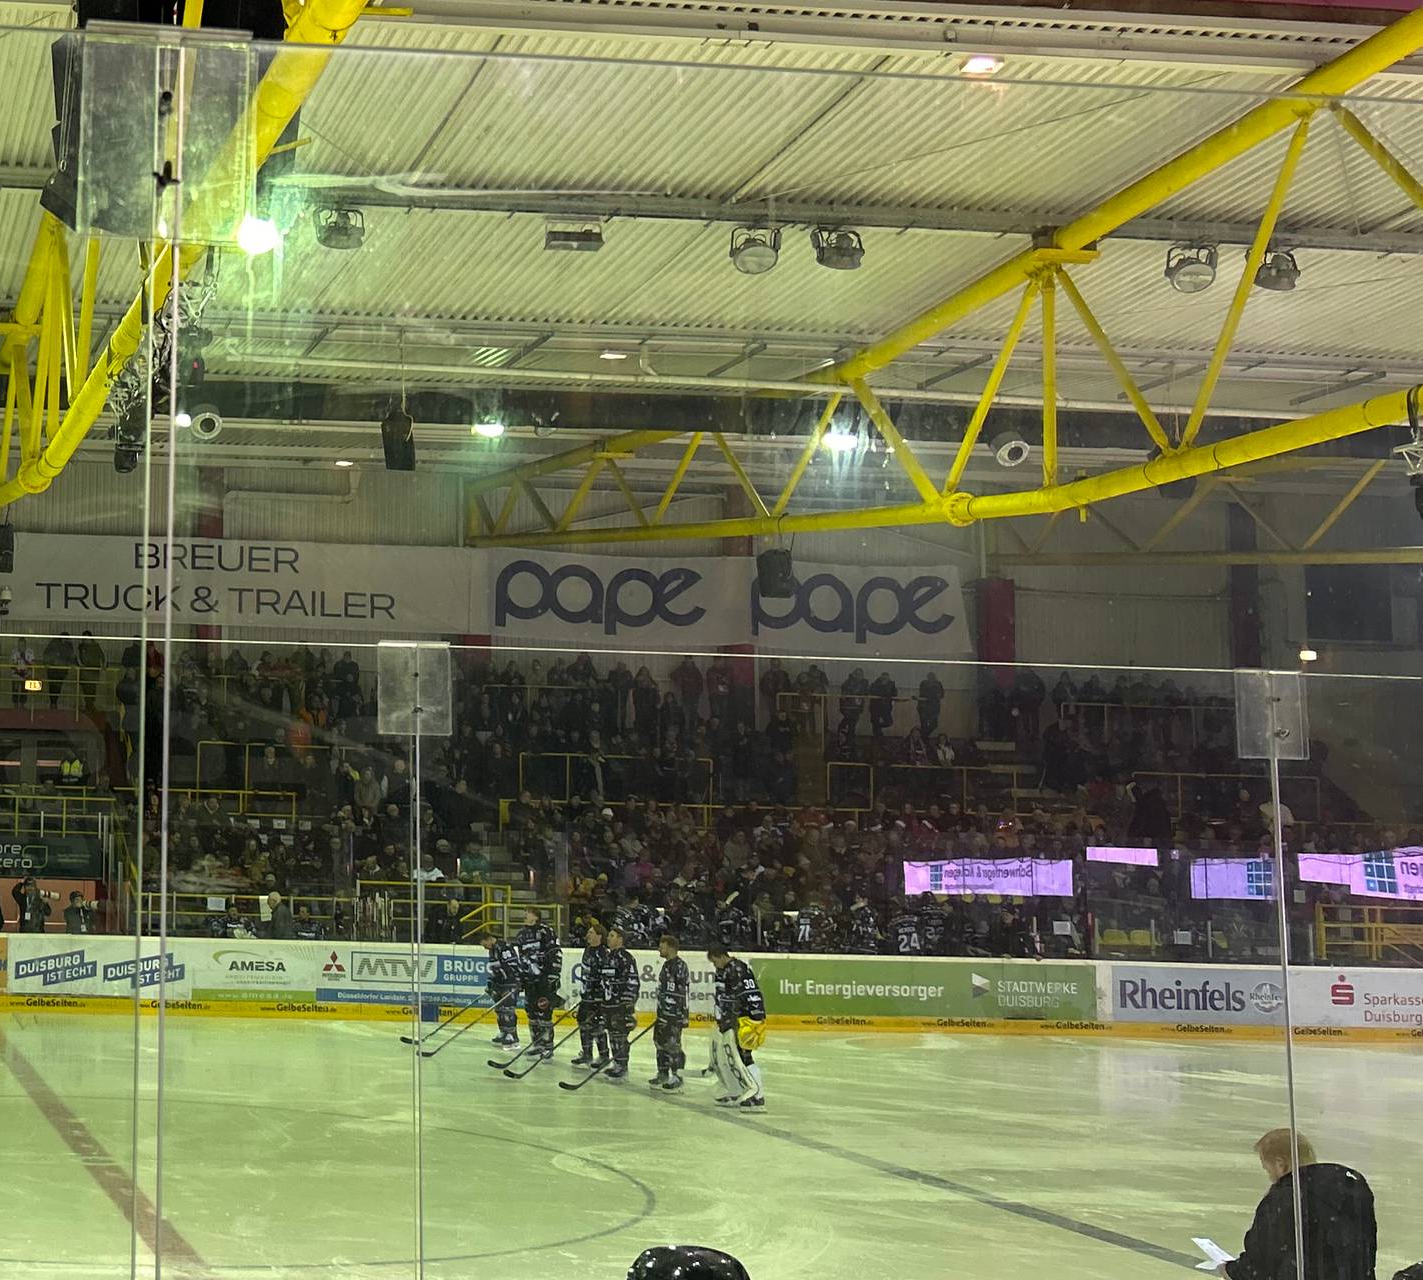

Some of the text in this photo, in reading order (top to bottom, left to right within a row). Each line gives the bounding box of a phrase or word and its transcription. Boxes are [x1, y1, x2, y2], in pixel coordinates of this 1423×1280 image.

[134, 542, 299, 573] BREUER
[35, 582, 396, 620] TRUCK & TRAILER
[495, 559, 706, 635] pape
[751, 573, 955, 644] pape
[898, 933, 920, 952] 24
[18, 954, 81, 976] DUISBURG
[229, 961, 286, 972] AMESA
[46, 965, 93, 982] IST ECHT
[153, 968, 181, 981] EHT
[443, 974, 479, 982] GRUPPE
[666, 981, 676, 992] 19
[743, 978, 755, 989] 30
[779, 980, 944, 1000] Ihr Energieversorger
[997, 980, 1077, 994] STADTWERKE
[997, 995, 1060, 1008] DUISBURG
[1119, 978, 1246, 1012] Rheinfels
[1364, 993, 1423, 1007] Sparkass
[1364, 1010, 1423, 1025] Duisburg
